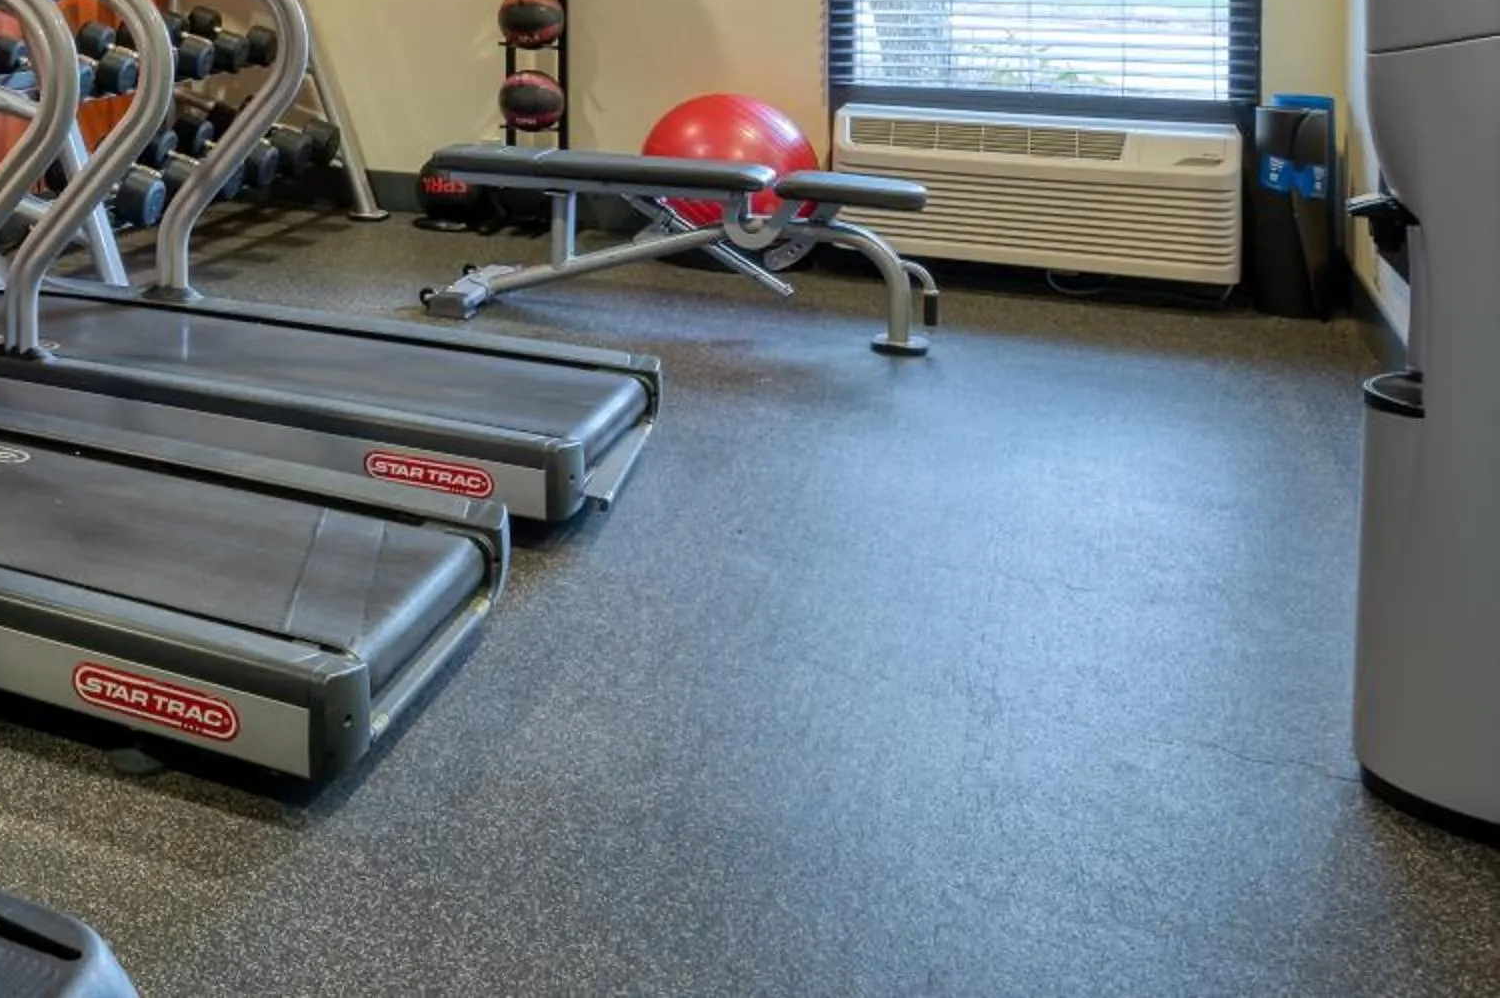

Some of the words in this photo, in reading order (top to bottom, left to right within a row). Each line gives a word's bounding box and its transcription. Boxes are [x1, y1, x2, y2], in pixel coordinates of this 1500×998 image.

[372, 461, 424, 480] STAR
[428, 468, 482, 489] TRAC
[79, 677, 148, 707] STAR
[152, 694, 224, 727] TRAC
